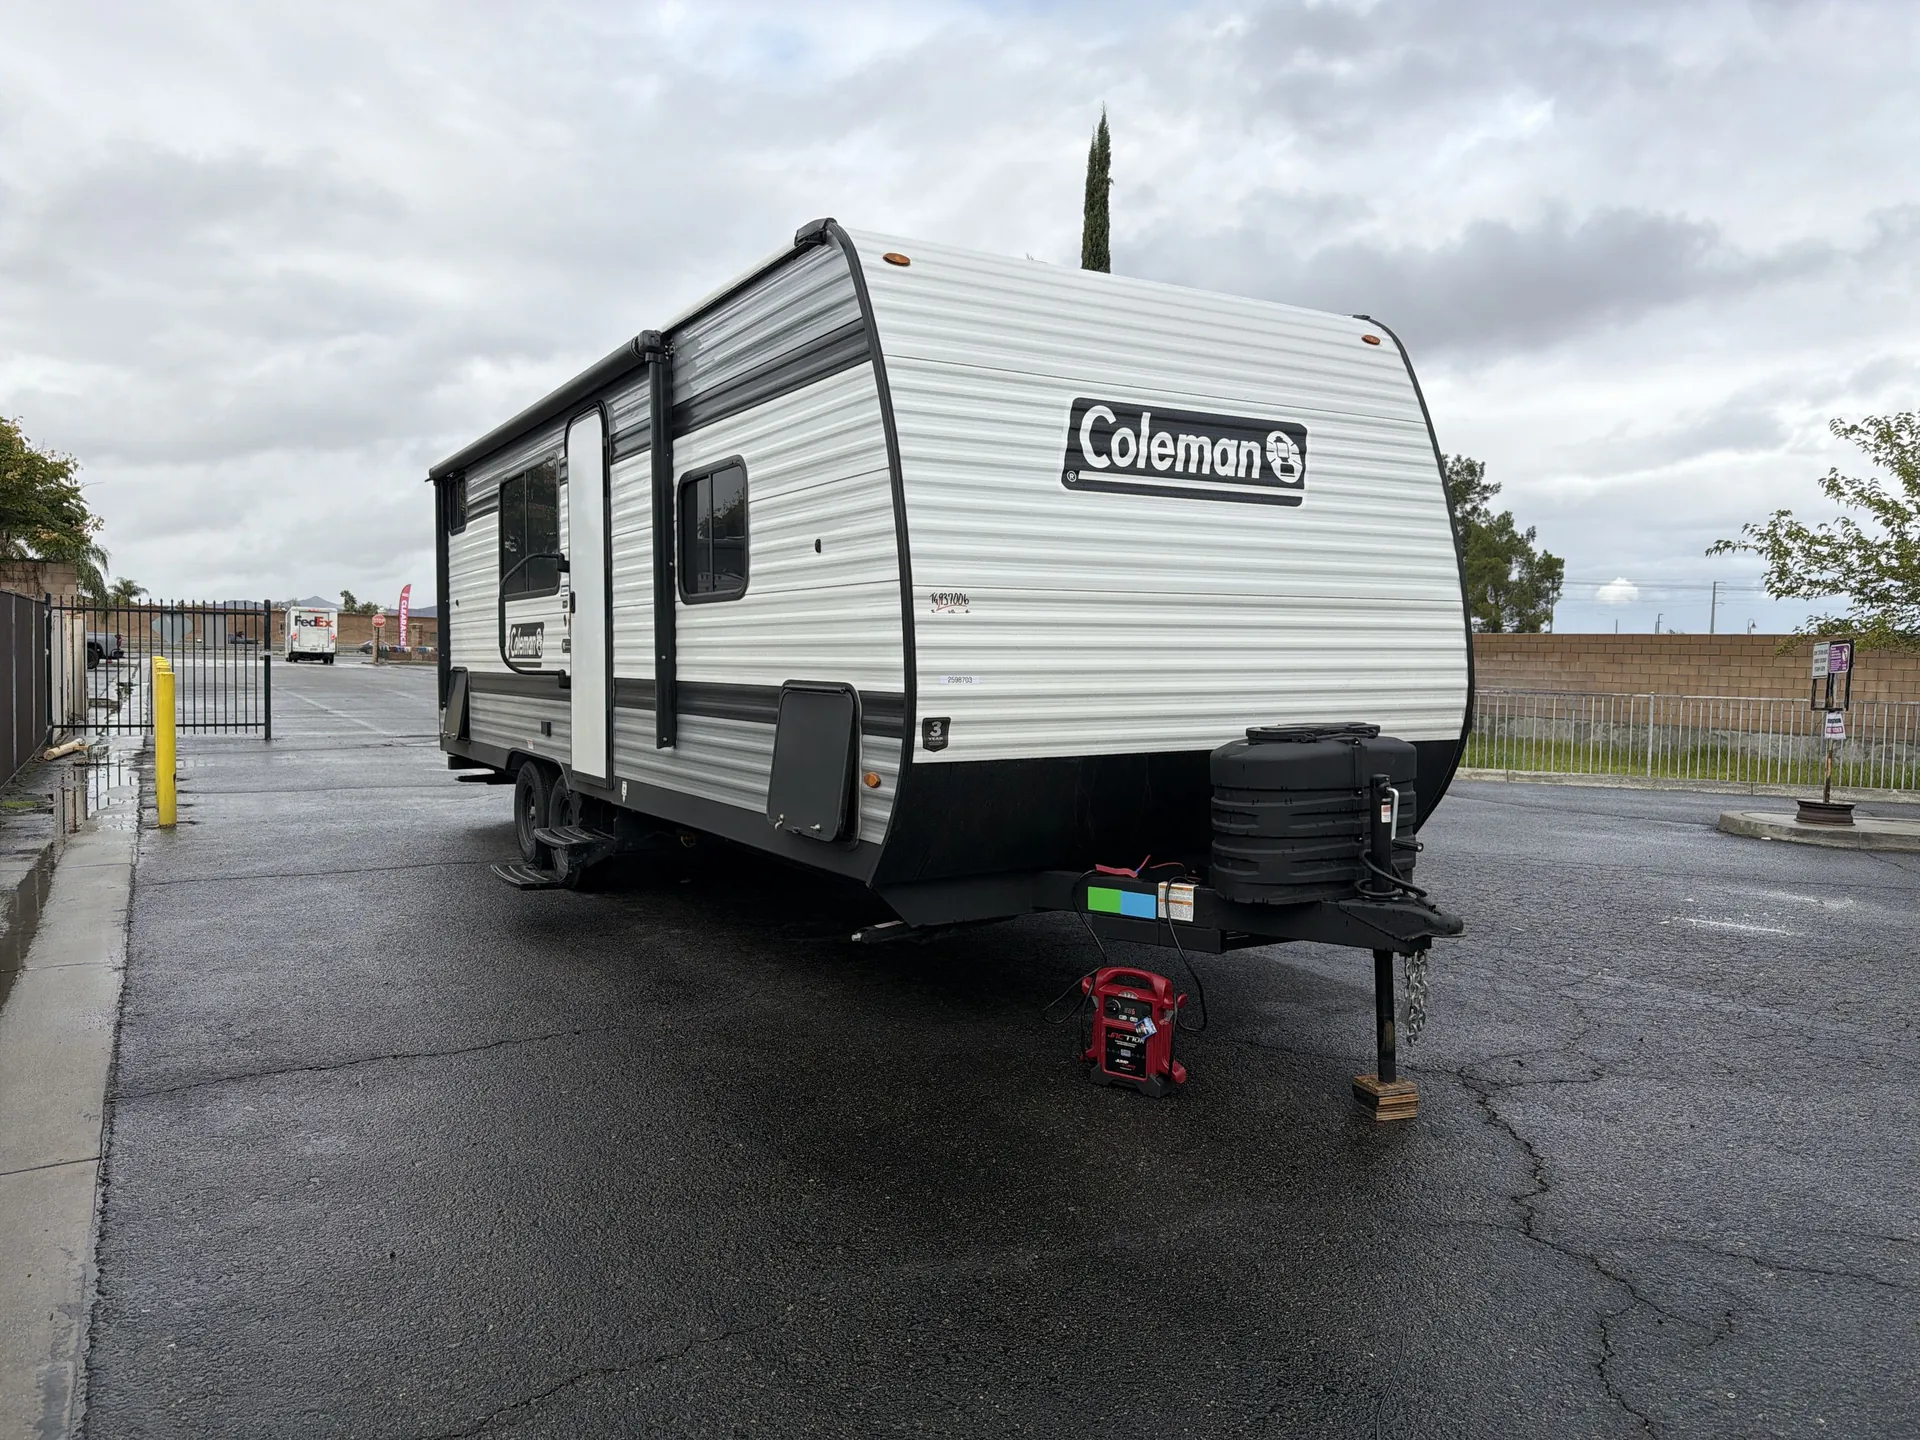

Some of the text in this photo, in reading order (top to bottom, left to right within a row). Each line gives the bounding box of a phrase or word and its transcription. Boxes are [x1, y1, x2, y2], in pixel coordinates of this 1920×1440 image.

[1079, 404, 1261, 480] Coleman
[295, 616, 333, 628] FedEx
[400, 599, 408, 646] CLEARANCE
[510, 626, 537, 657] Coleman
[929, 720, 942, 737] 3
